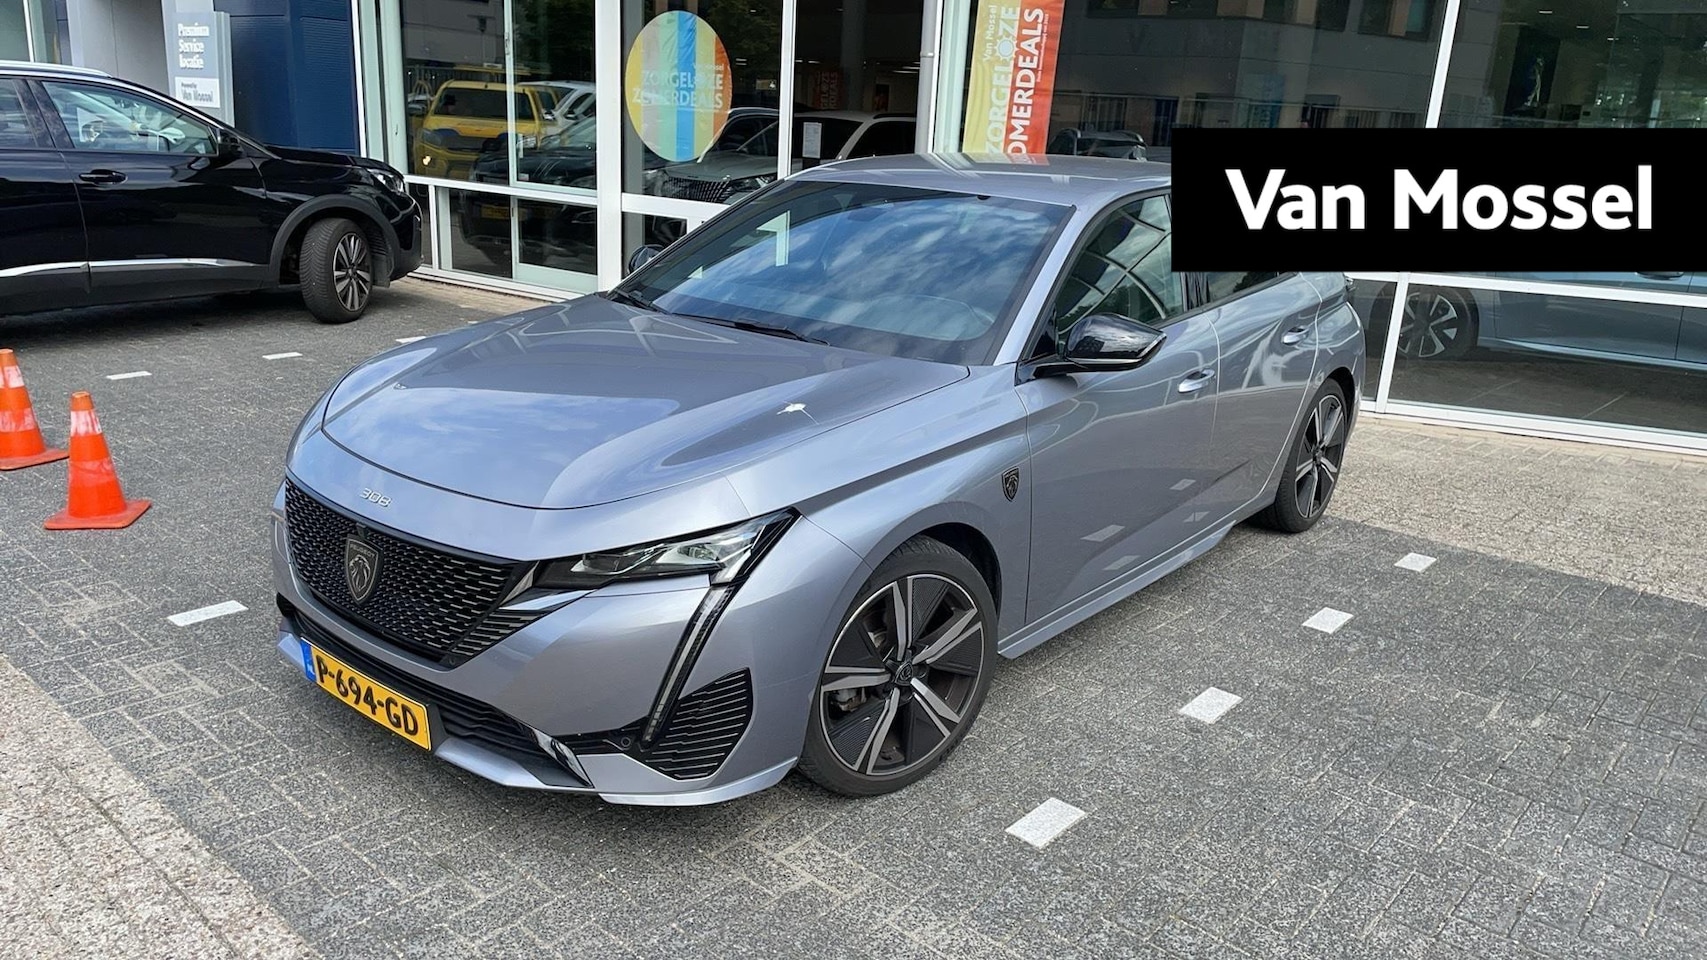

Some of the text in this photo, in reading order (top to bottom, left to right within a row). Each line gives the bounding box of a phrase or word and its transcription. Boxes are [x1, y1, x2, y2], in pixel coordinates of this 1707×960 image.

[177, 22, 210, 37] Premium
[982, 4, 998, 62] Van Mossel
[178, 38, 205, 53] Service
[1007, 8, 1044, 155] OMERDEALS
[360, 487, 392, 508] 308
[349, 543, 375, 558] PEUGEOT
[316, 655, 419, 736] P-694-GD
